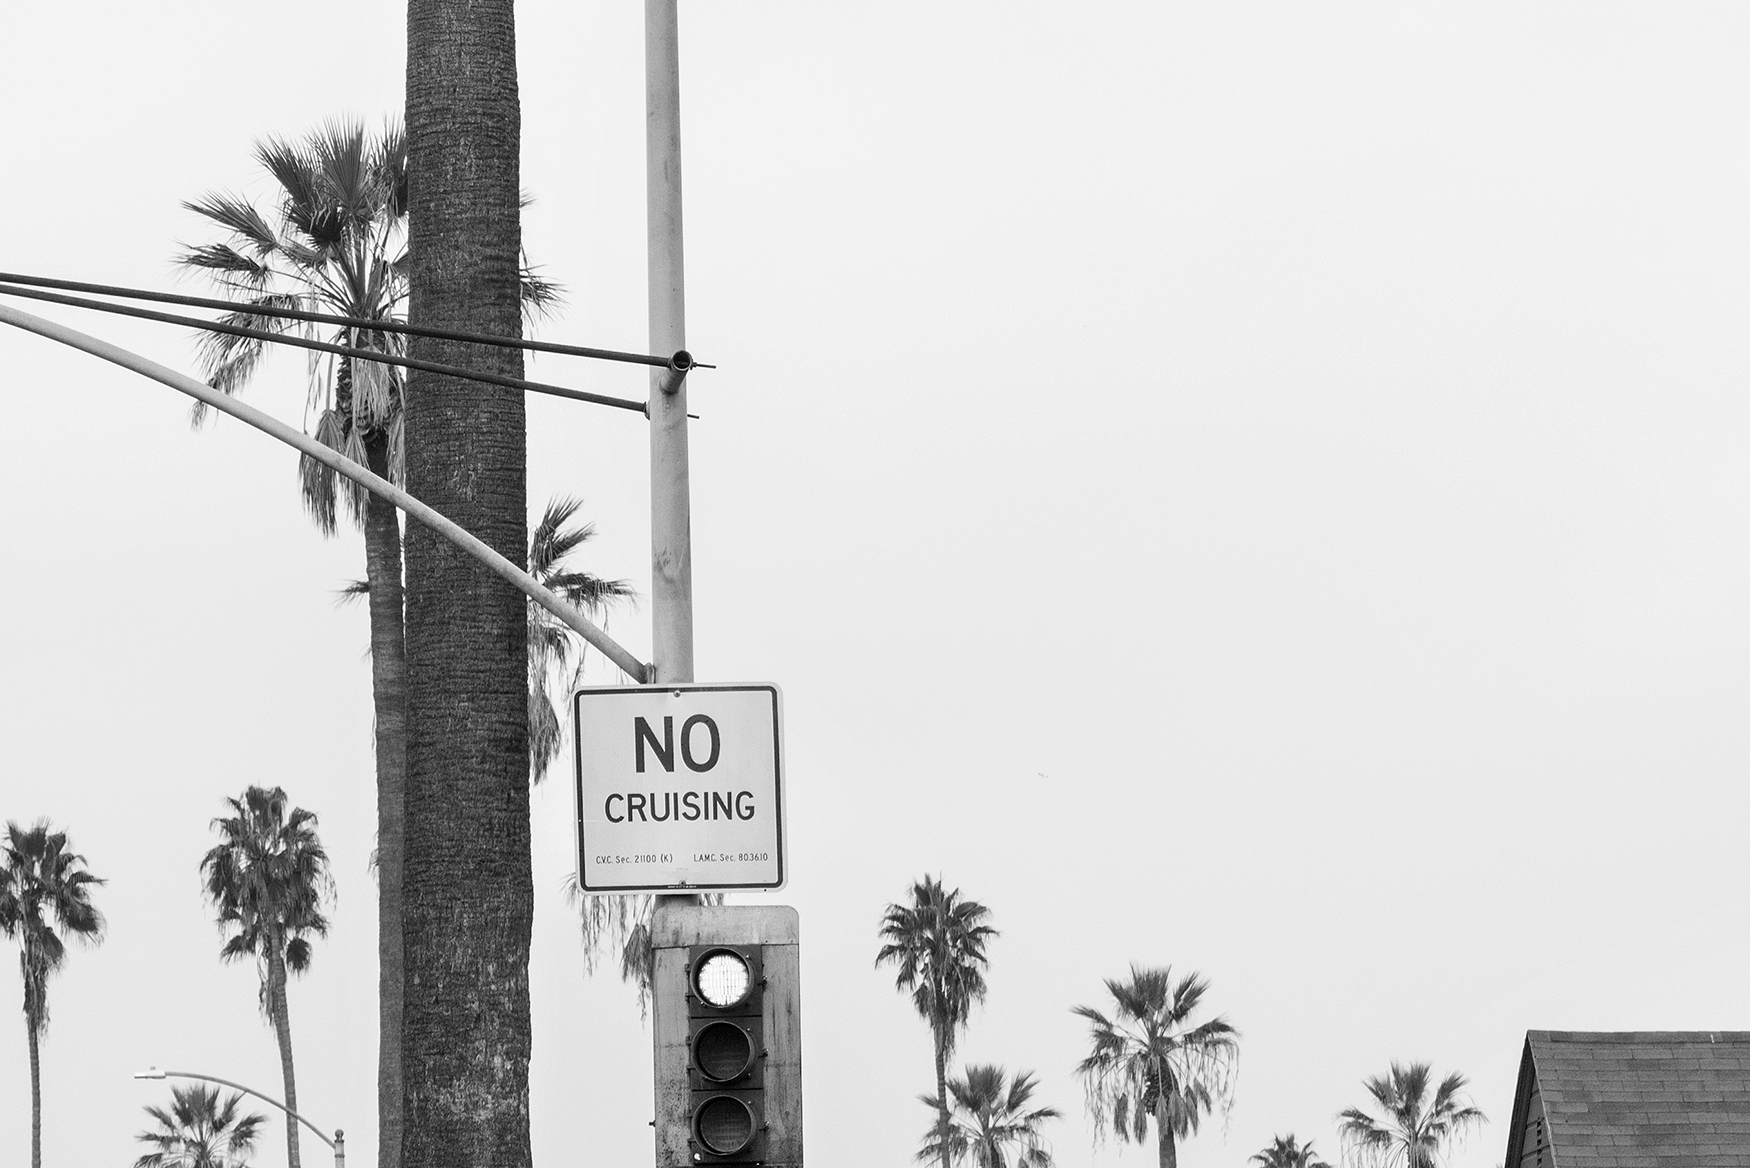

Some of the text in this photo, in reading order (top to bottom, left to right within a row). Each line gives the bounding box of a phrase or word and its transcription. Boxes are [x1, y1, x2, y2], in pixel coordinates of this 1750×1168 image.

[634, 714, 720, 773] NO
[605, 791, 755, 823] CRUISING
[615, 855, 632, 864] Sec.
[634, 854, 657, 864] 21100
[660, 853, 673, 864] (K)
[719, 853, 736, 862] Sec.
